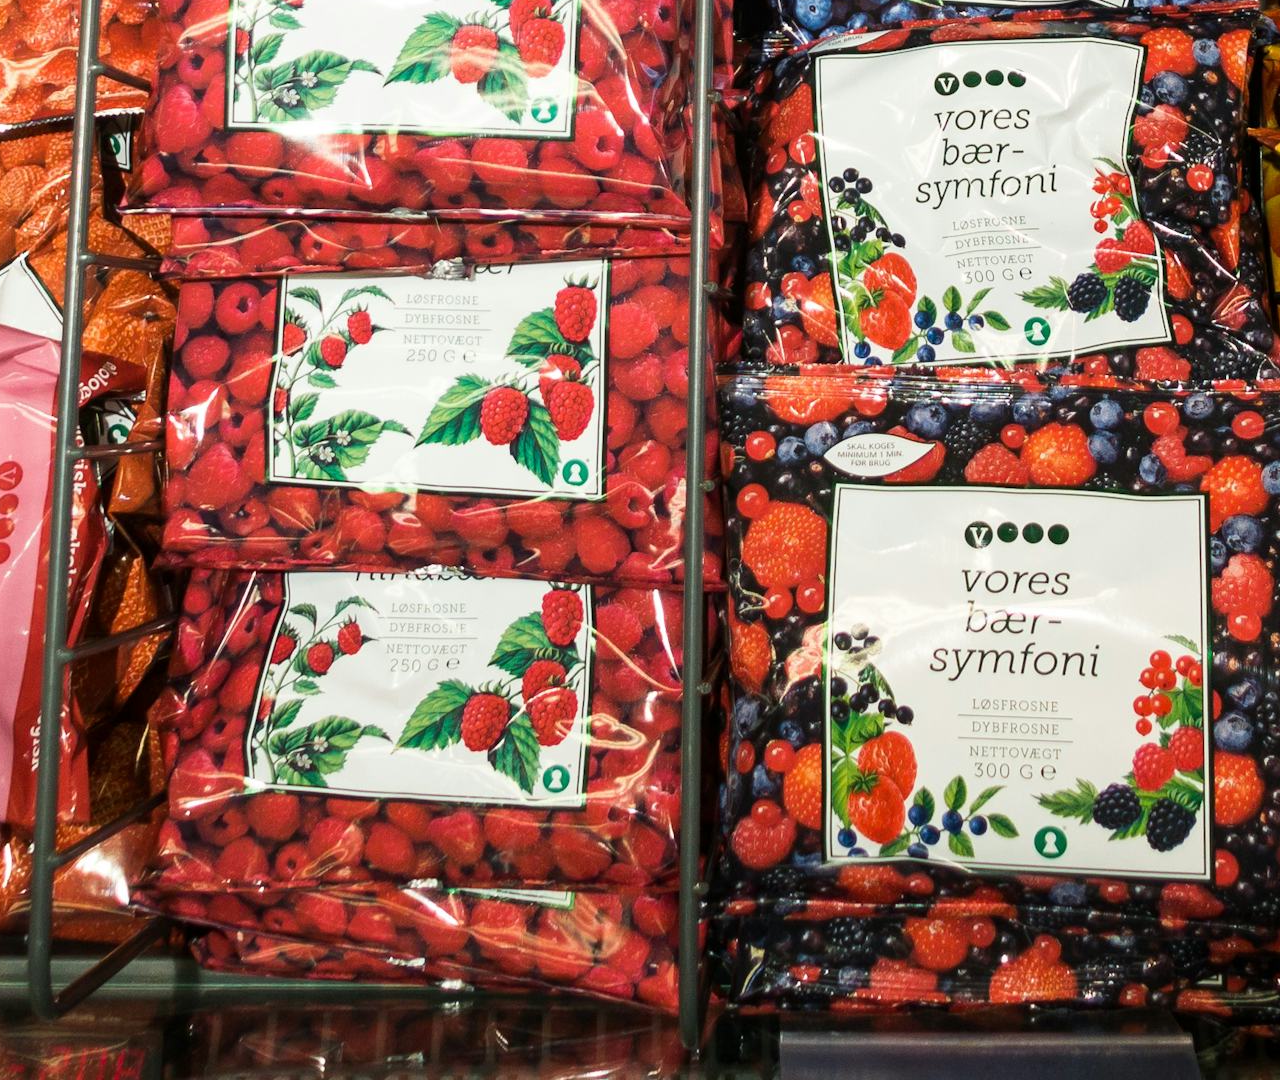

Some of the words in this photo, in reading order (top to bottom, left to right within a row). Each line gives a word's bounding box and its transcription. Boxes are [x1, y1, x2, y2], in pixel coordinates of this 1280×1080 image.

[934, 106, 1030, 132] vores
[942, 138, 1024, 167] bær-
[915, 165, 1058, 210] symfoni
[952, 215, 1027, 231] LØSFROSNE
[957, 254, 1034, 269] NETTOVÆGT
[962, 270, 995, 285] 300
[405, 293, 479, 306] LØSFROSNE
[404, 313, 481, 325] DYBFROSNE
[402, 334, 483, 347] NETTOVÆGT
[405, 349, 438, 363] 250
[961, 568, 1071, 596] vores
[390, 603, 467, 614] LØSFROSNE
[965, 600, 1062, 635] bær-
[385, 643, 468, 655] NETTOVÆGT
[389, 657, 422, 673] 250
[929, 644, 1100, 681] symfoni
[971, 698, 1059, 712] LØSFROSNE
[971, 721, 1059, 735] DYBFROSNE
[968, 745, 1062, 761] NETTOVÆGT
[973, 762, 1010, 779] 300
